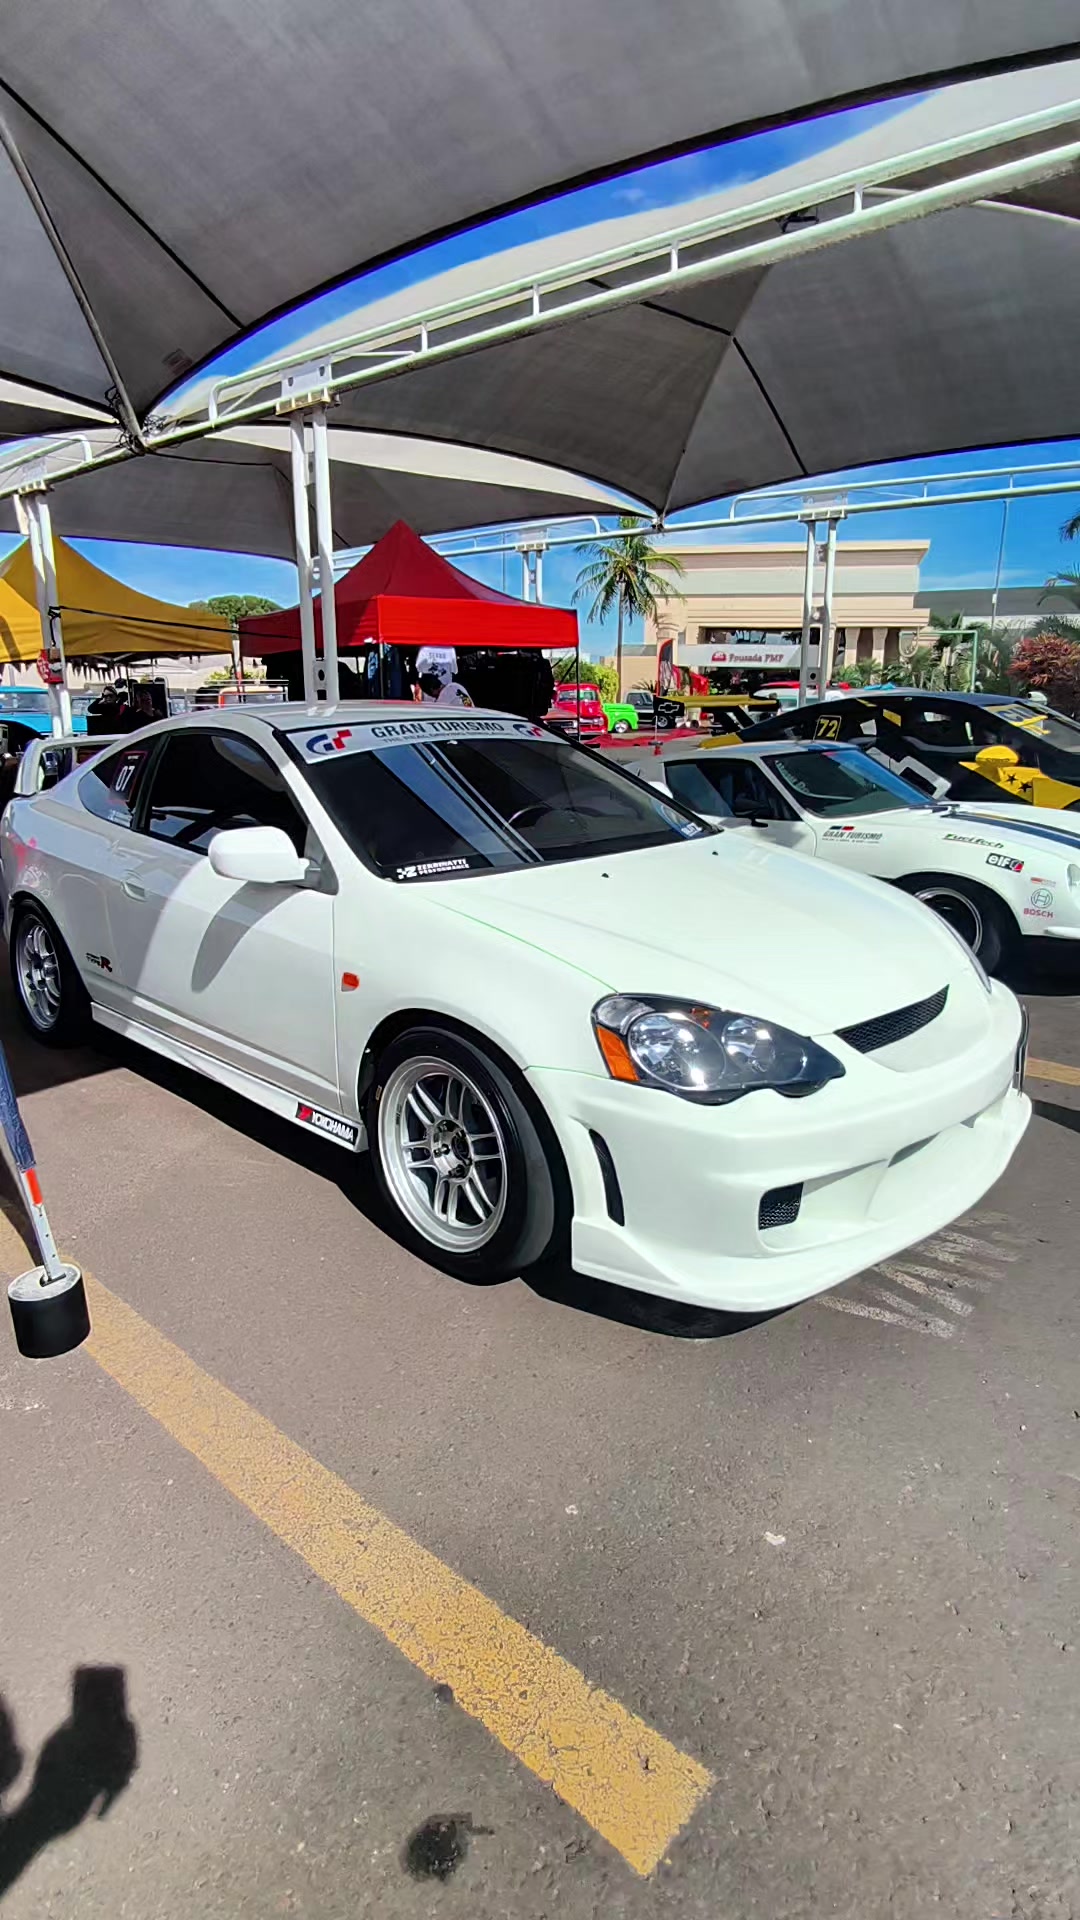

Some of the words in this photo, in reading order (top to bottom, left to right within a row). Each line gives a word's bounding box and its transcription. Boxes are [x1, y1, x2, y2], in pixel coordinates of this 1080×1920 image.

[371, 722, 426, 738] GRAN
[426, 721, 505, 732] TURISMO
[817, 718, 838, 738] 72
[115, 765, 135, 791] 07
[823, 830, 846, 838] GRAN
[845, 831, 883, 840] TURISMO
[988, 854, 1011, 868] elf
[1023, 908, 1054, 919] BOSCH
[312, 1111, 354, 1142] YOKOHAMA
